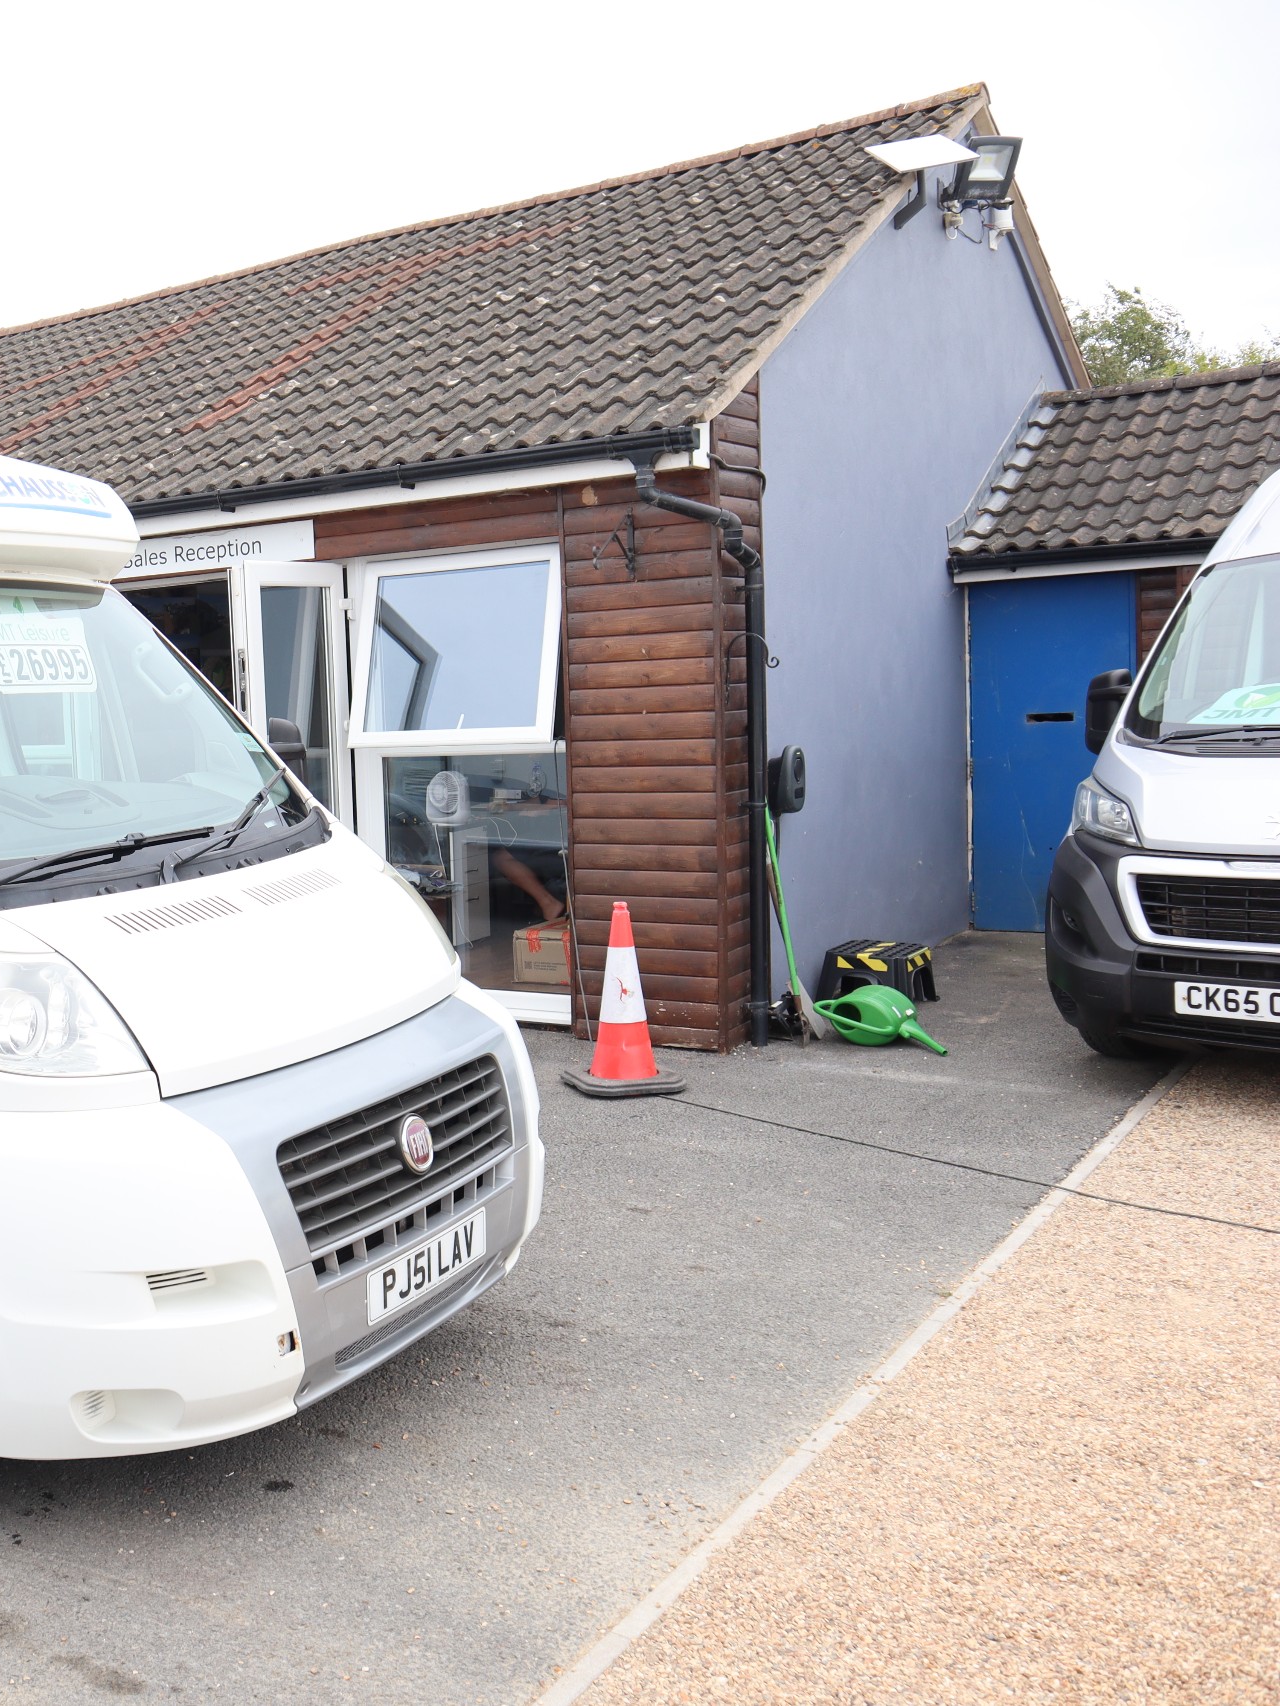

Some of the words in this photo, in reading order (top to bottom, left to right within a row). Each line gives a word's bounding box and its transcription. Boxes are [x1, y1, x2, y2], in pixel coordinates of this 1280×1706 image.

[174, 539, 262, 563] Reception
[17, 623, 71, 641] Leisure
[1187, 985, 1260, 1015] CK65
[382, 1246, 432, 1310] PJ51
[432, 1221, 475, 1277] LAV
